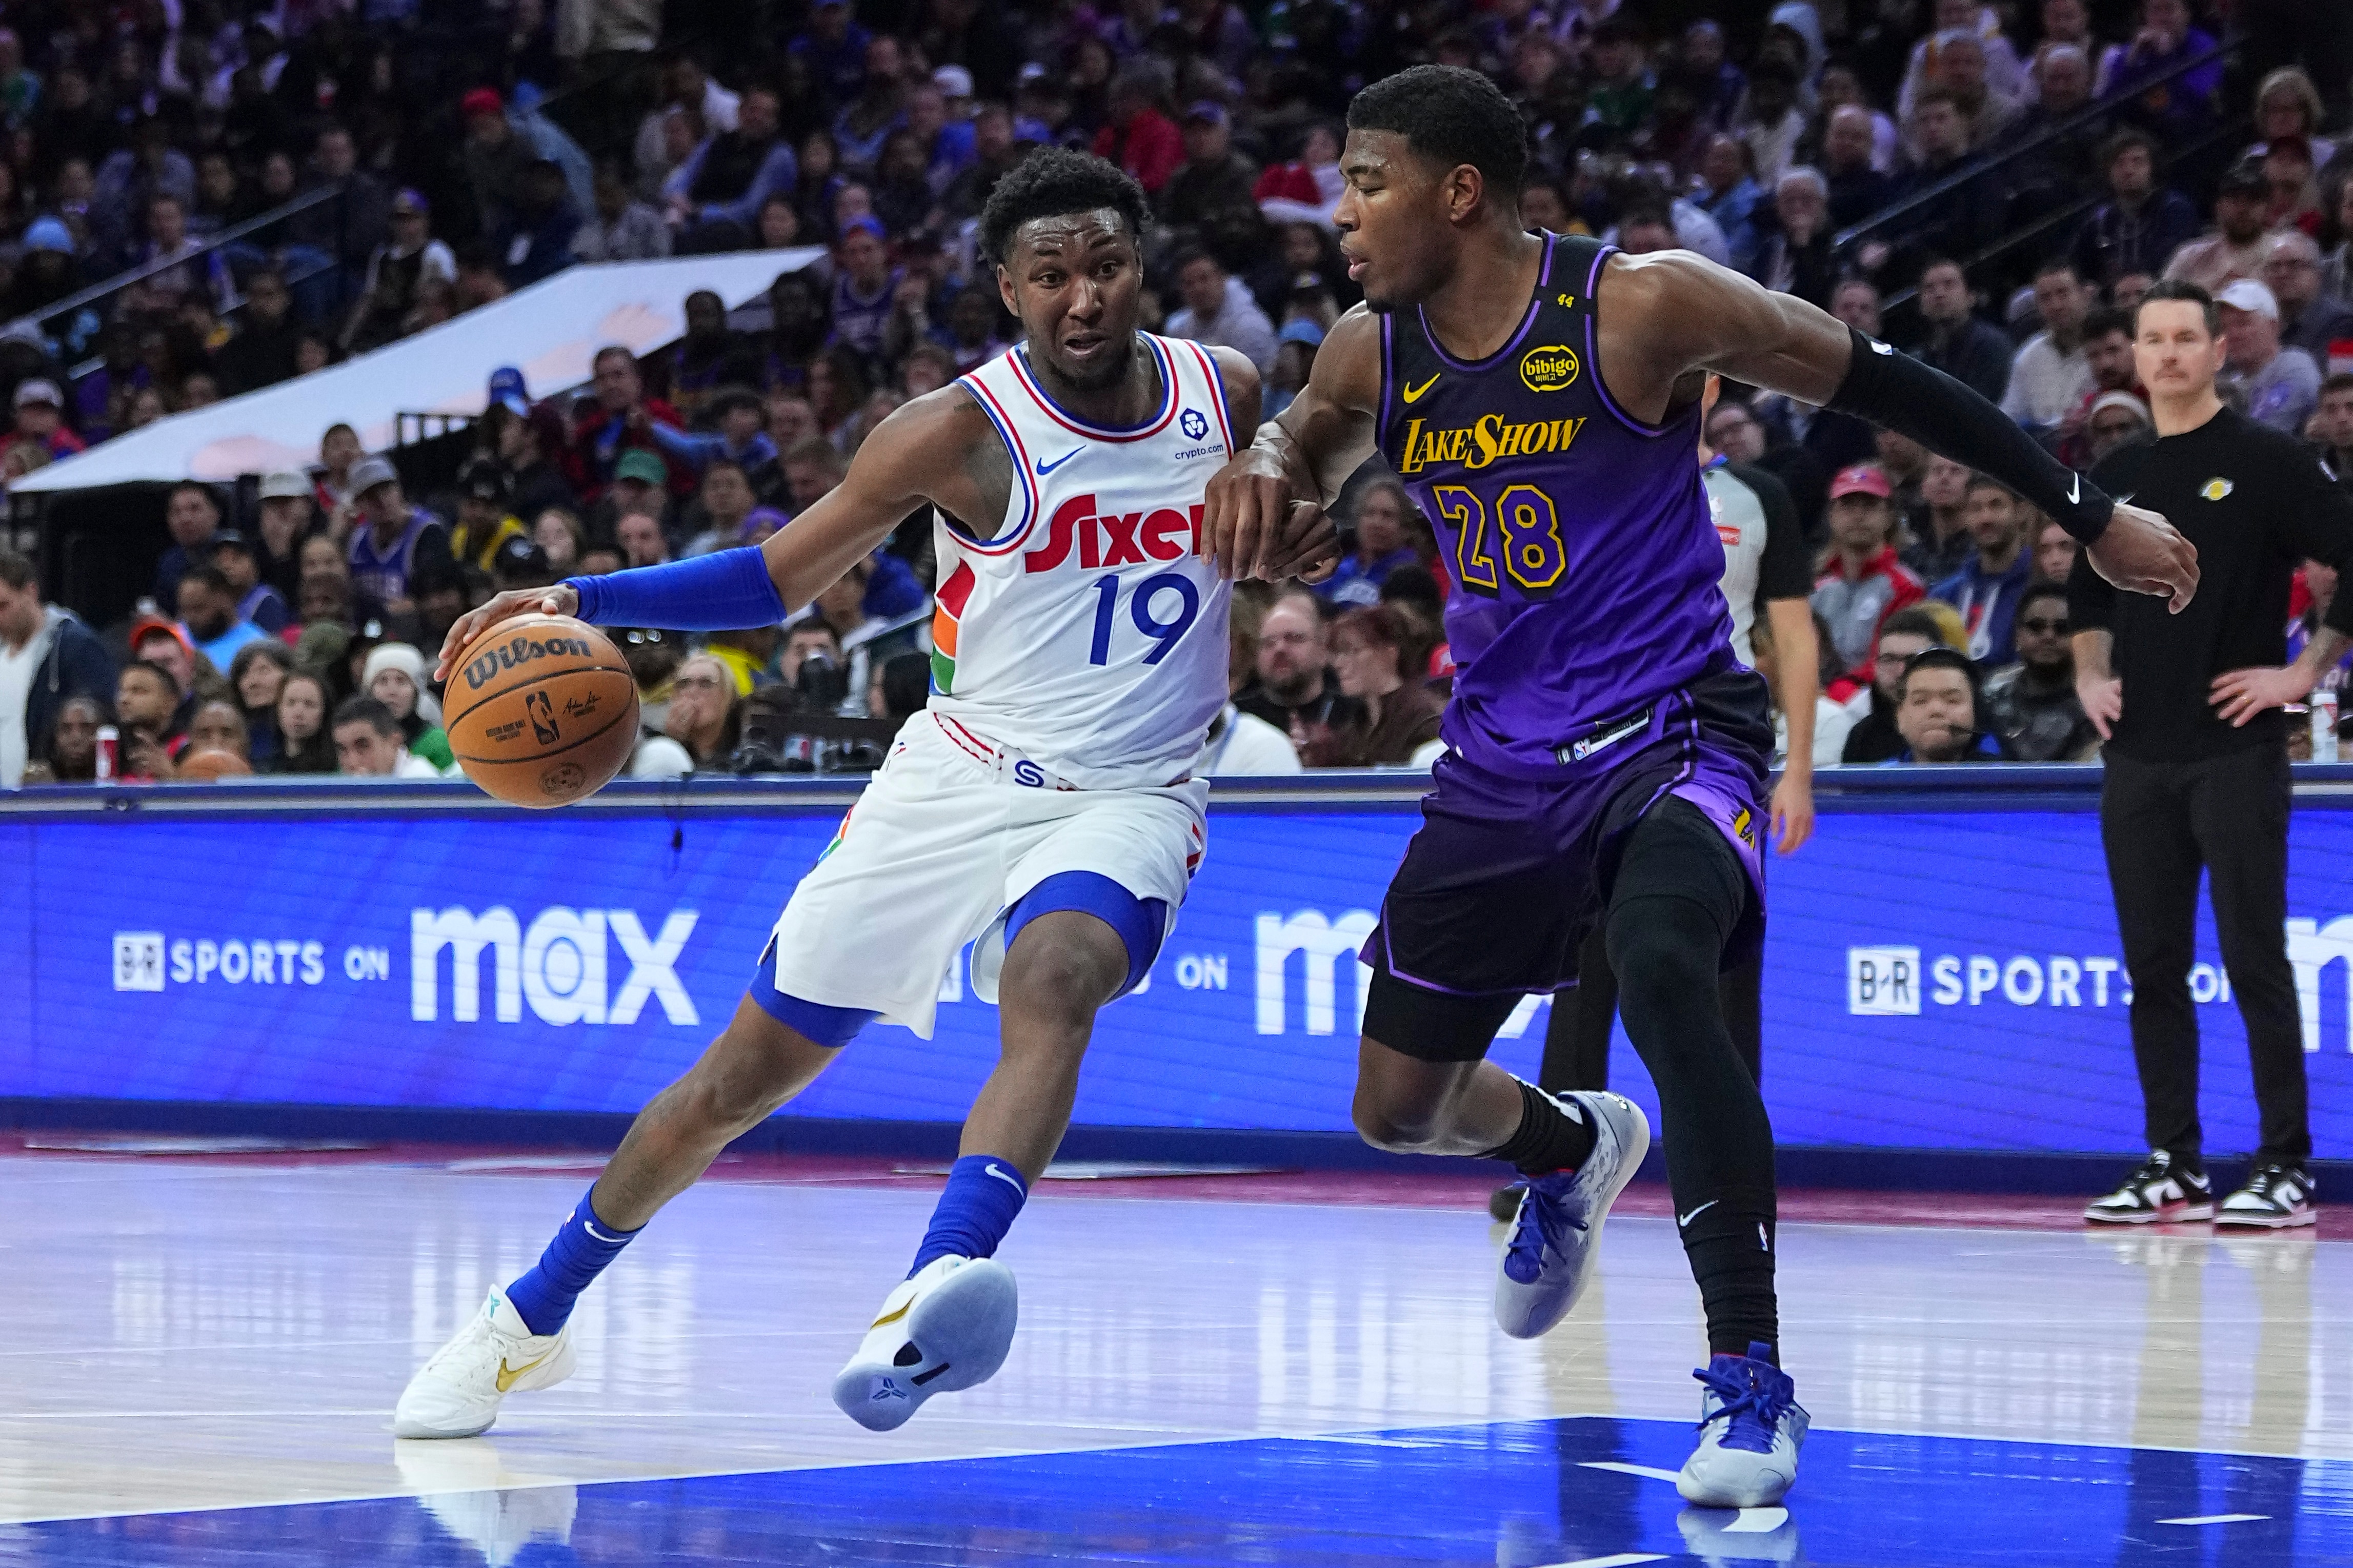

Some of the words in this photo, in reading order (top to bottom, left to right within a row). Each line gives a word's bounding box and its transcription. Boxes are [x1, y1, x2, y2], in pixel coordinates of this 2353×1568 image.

[1557, 293, 1575, 308] 44
[1525, 357, 1576, 377] bibigo
[1535, 373, 1557, 382] 비비고
[1175, 444, 1224, 460] crypto.com
[1025, 494, 1206, 574] Sixe
[1432, 484, 1566, 590] 28
[1090, 573, 1199, 666] 19
[463, 637, 592, 690] Wilson
[171, 939, 325, 985] SPORTS
[345, 947, 390, 980] ON
[411, 906, 701, 1026] max
[1176, 954, 1226, 990] ON
